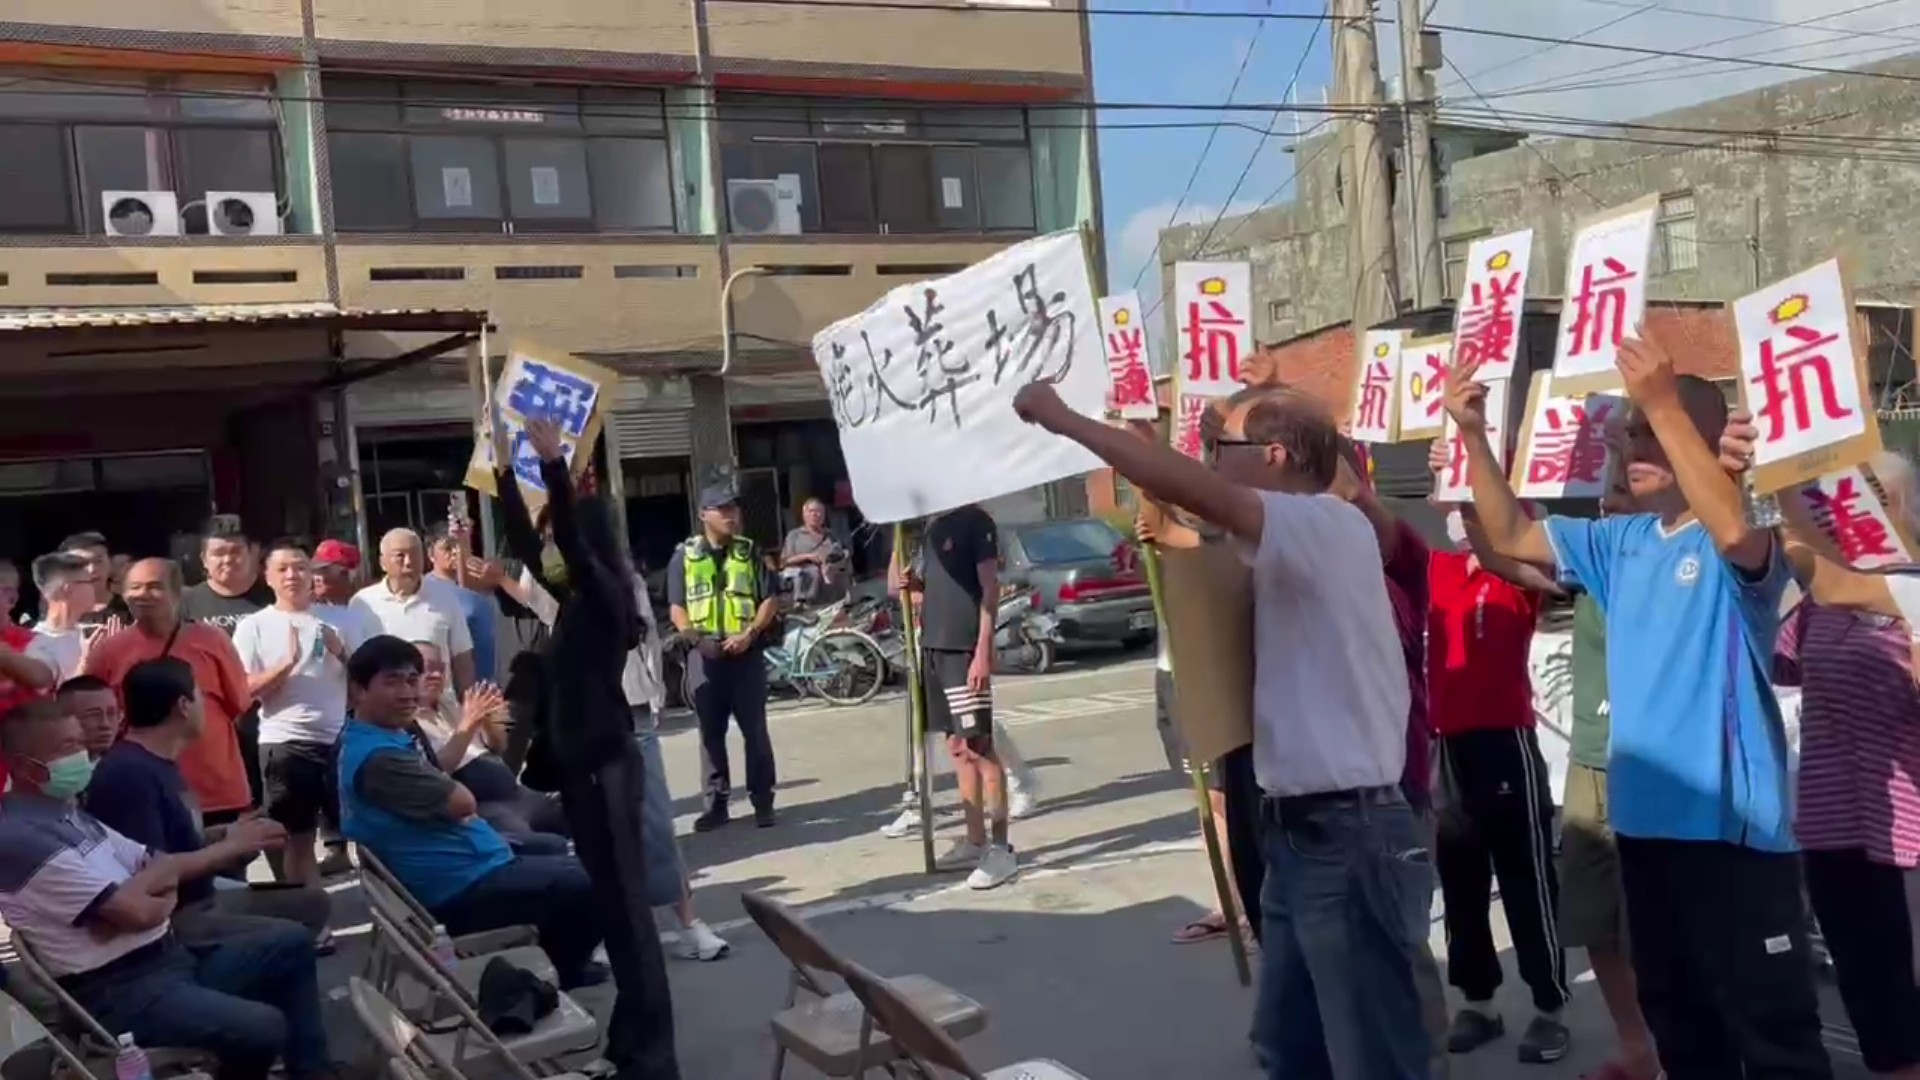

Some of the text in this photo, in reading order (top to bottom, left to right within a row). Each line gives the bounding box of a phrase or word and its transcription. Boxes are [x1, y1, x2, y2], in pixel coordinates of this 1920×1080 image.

[1182, 302, 1247, 383] 抗
[1456, 271, 1522, 366] 議
[1567, 257, 1637, 356] 抗
[1107, 328, 1152, 404] 議
[1356, 361, 1394, 430] 抗
[1751, 325, 1853, 443] 抗
[1527, 405, 1614, 484] 議
